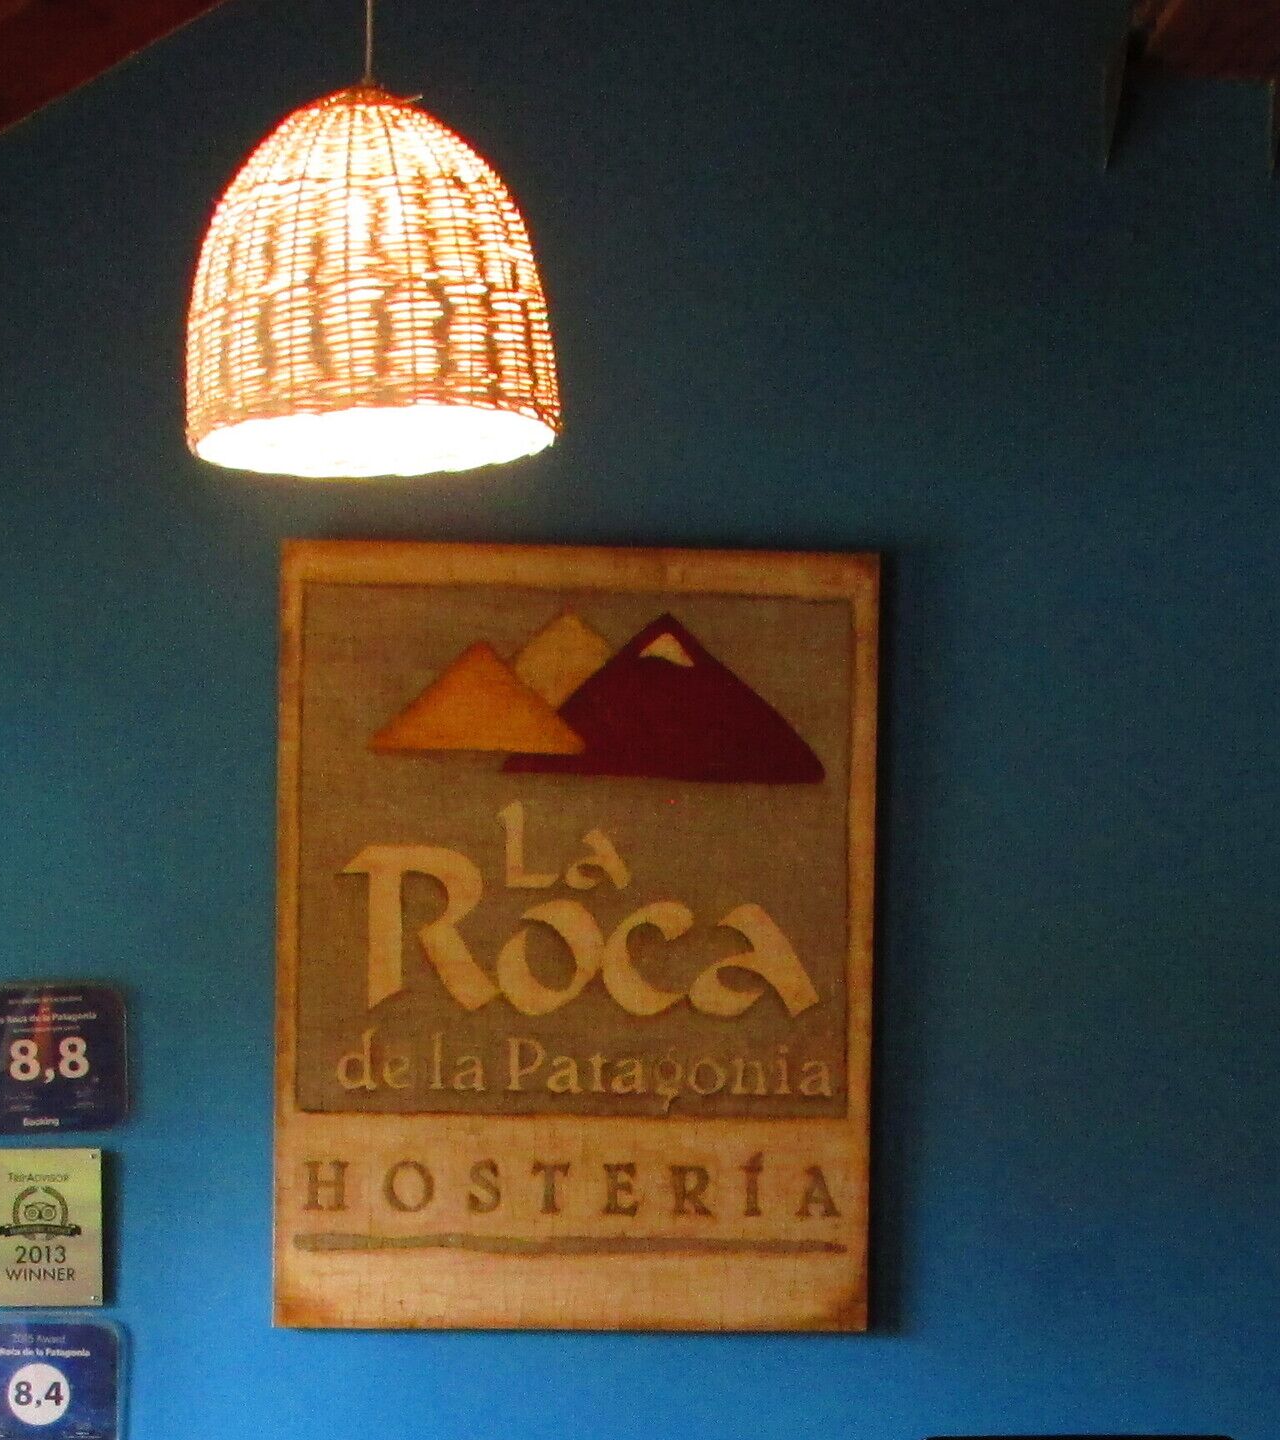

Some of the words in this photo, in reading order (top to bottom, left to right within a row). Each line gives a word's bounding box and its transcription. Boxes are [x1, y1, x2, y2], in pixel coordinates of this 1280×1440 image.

[498, 802, 632, 889] La
[335, 844, 820, 1017] Roca
[10, 1036, 90, 1083] 8,8
[336, 1029, 412, 1092] de
[430, 1032, 486, 1092] la
[507, 1038, 834, 1112] Patagonia
[302, 1152, 842, 1219] HOSTERÍA
[5, 1268, 76, 1282] WINNER
[15, 1246, 67, 1264] 2013
[14, 1381, 65, 1408] 8,4
